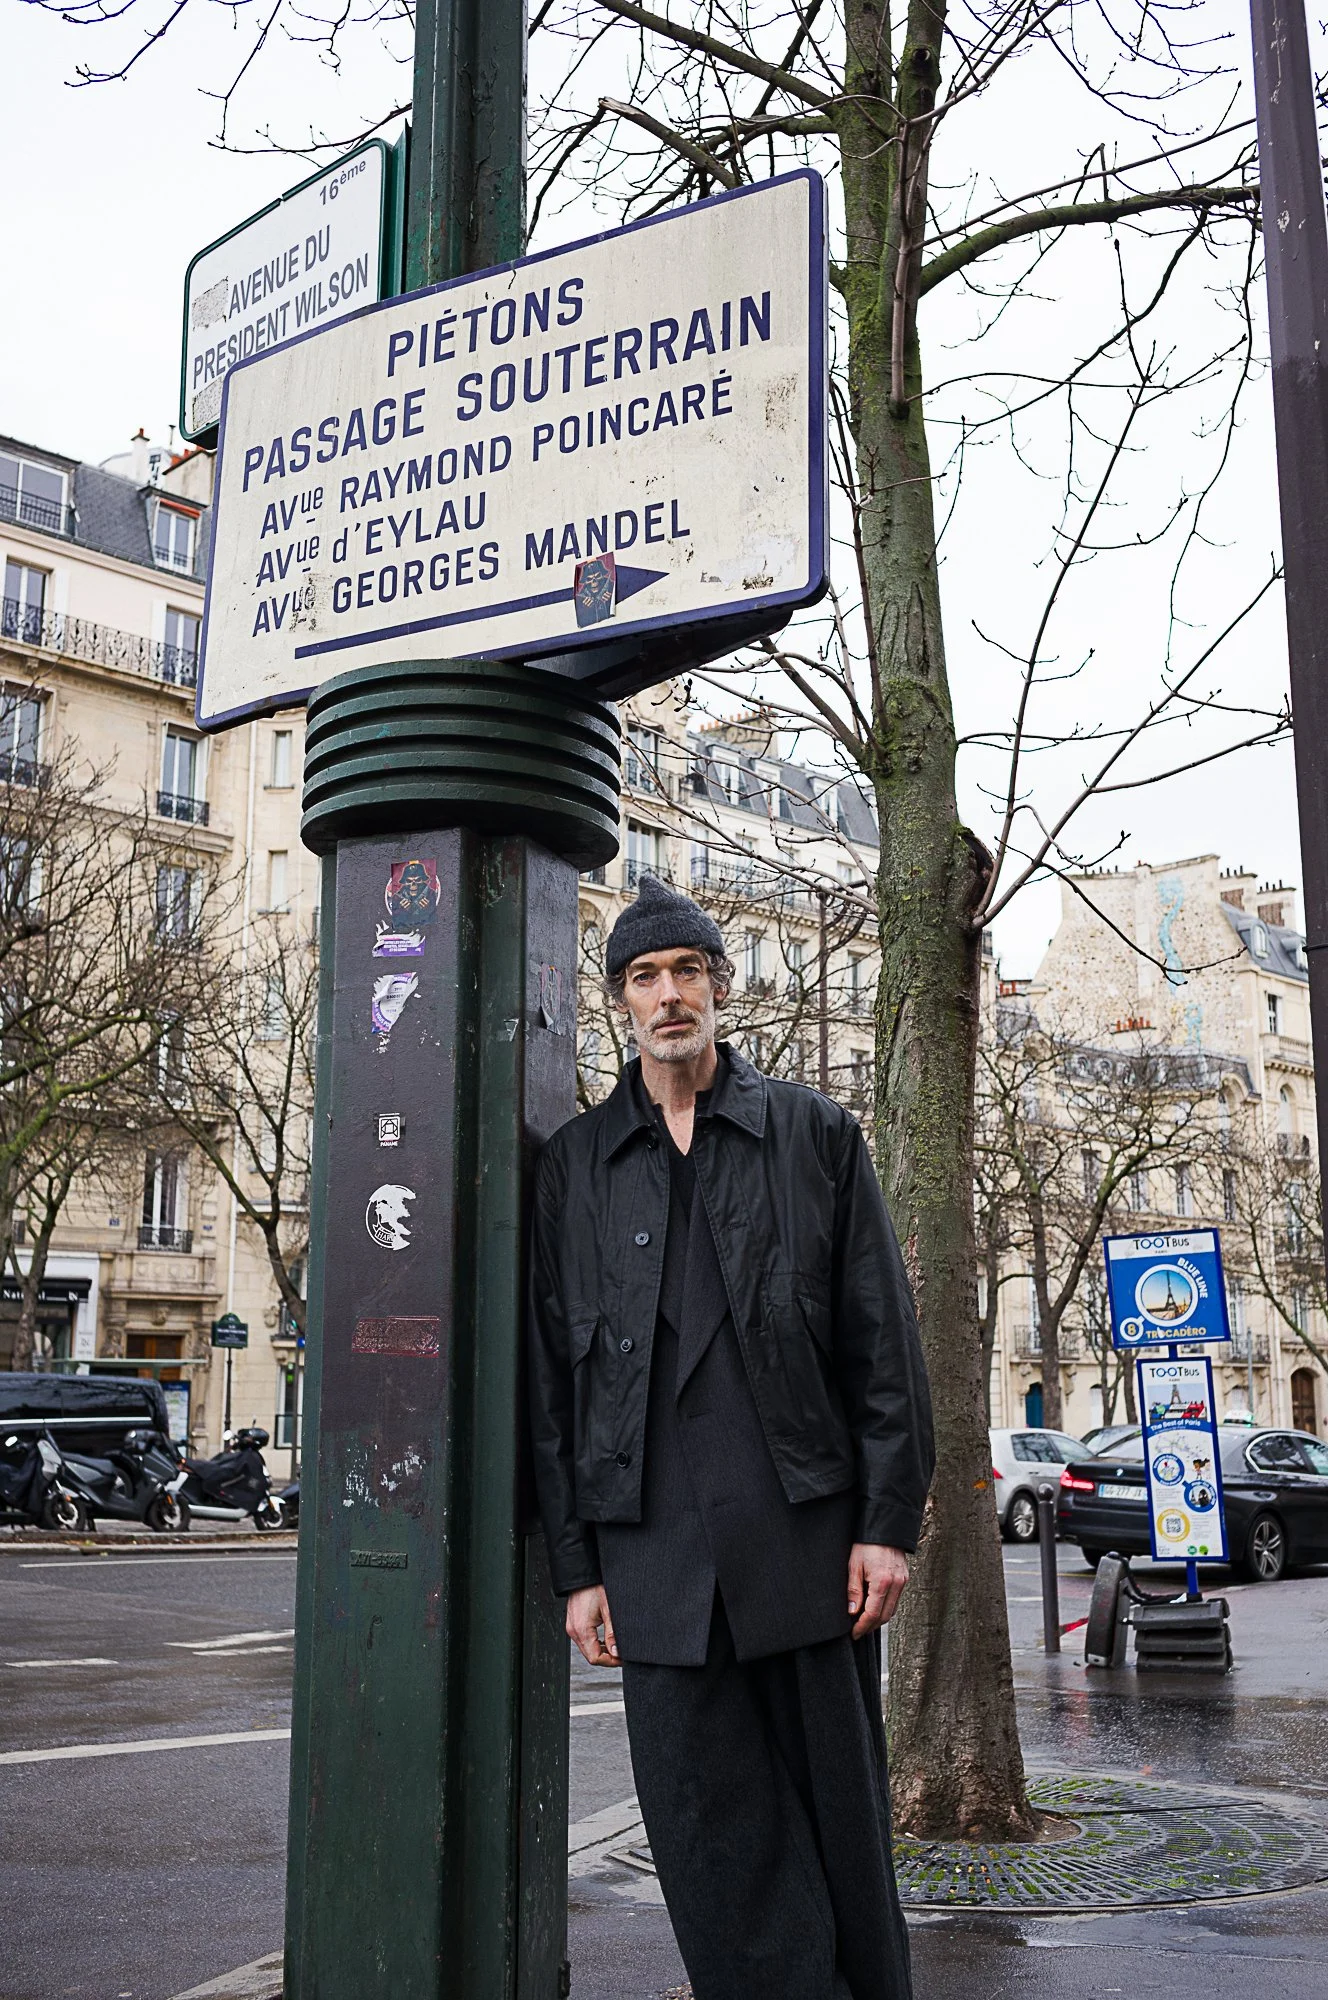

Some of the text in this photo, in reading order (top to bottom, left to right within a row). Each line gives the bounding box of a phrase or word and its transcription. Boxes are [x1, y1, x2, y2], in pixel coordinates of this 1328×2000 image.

[319, 159, 367, 206] 16ème
[228, 224, 330, 320] AVENUE DU
[193, 252, 369, 390] PRESIDENT WILSON
[387, 277, 584, 378] PIÉTONS
[242, 290, 771, 493] PASSAGE SOUTERRAIN
[339, 435, 512, 514] RAYMOND
[532, 368, 733, 462] POINCARÉ
[332, 491, 486, 564] d'EYLAU
[332, 541, 499, 614] GEORGES
[525, 498, 691, 571] MANDEL
[1177, 1257, 1208, 1299] BLUE LINE
[1127, 1324, 1136, 1335] 8
[1162, 1420, 1177, 1428] Best
[1177, 1418, 1184, 1426] of
[1184, 1418, 1201, 1426] Paris
